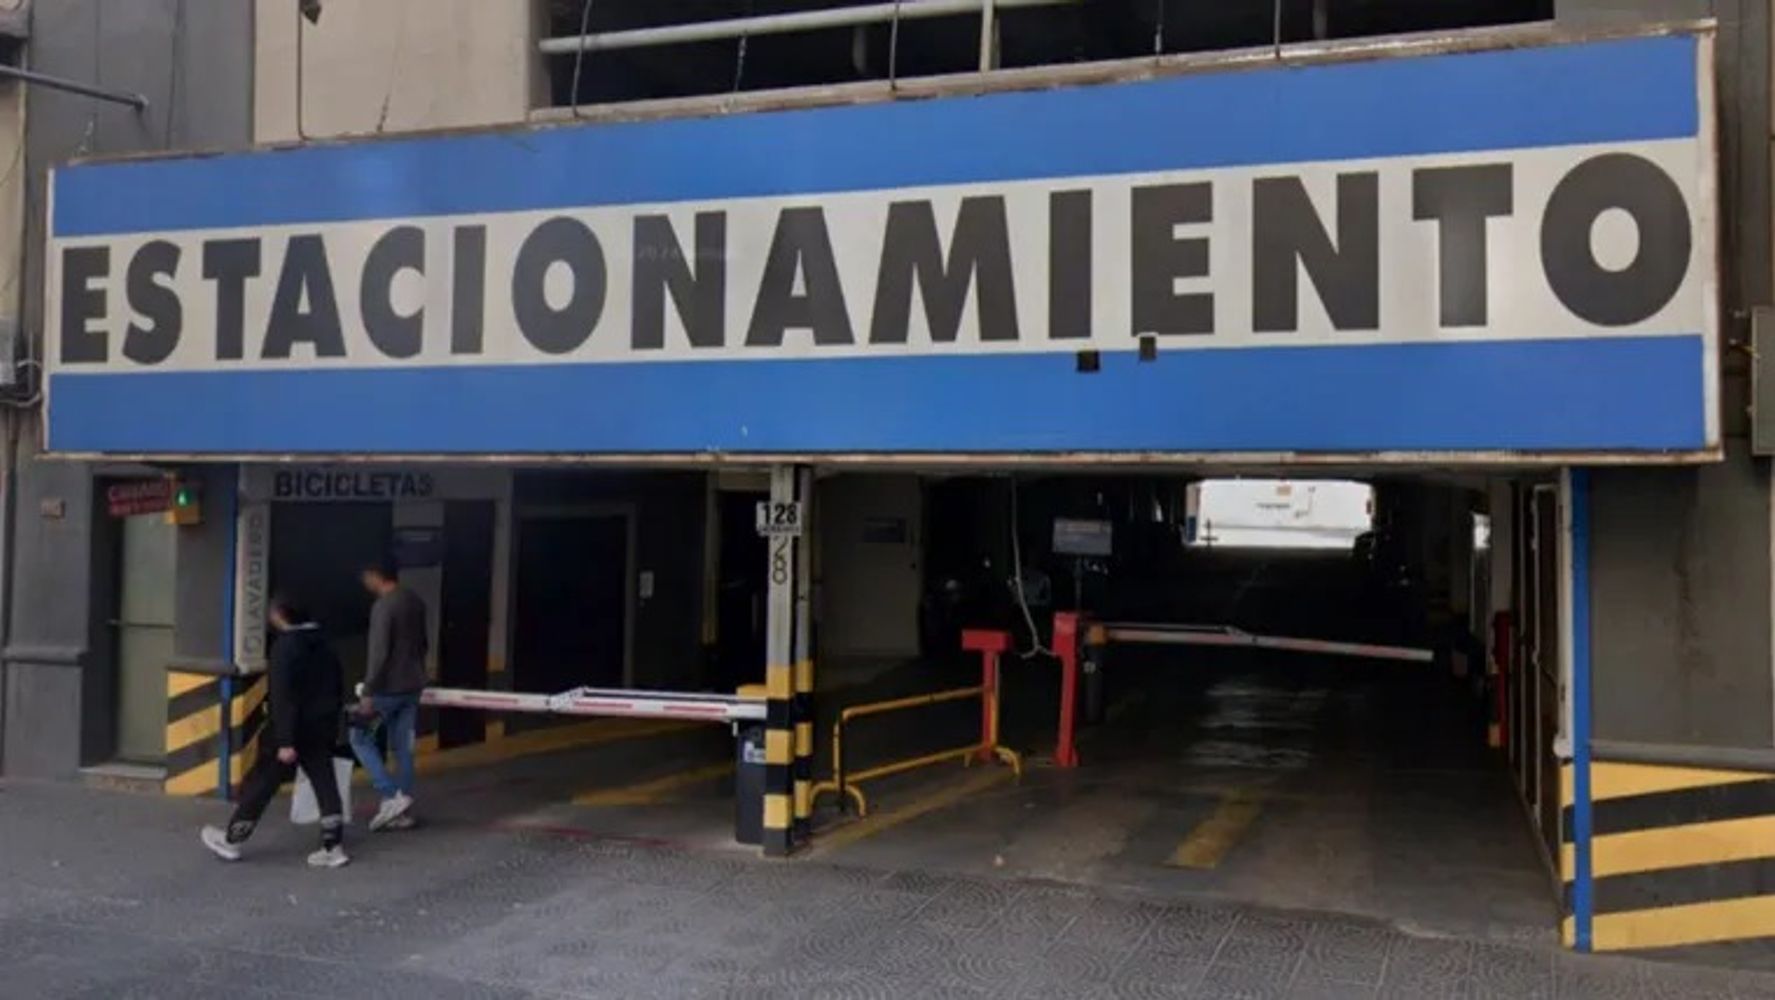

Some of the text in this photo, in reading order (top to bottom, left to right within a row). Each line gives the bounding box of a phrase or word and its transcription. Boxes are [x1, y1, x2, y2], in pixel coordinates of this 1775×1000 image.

[60, 151, 1692, 365] ESTACIONAMIENTO
[274, 473, 435, 498] BICICLETAS
[764, 503, 797, 524] 128
